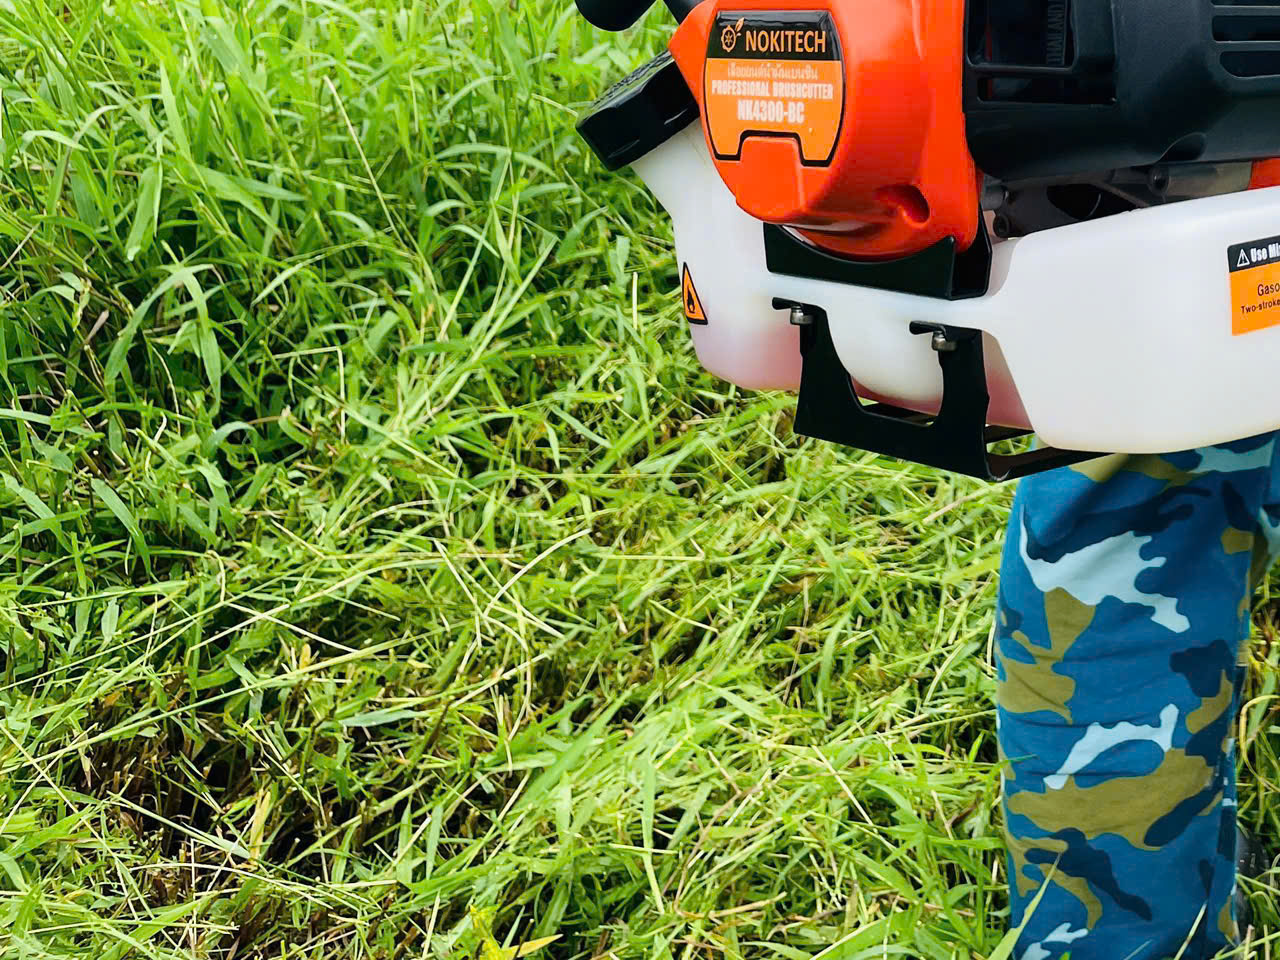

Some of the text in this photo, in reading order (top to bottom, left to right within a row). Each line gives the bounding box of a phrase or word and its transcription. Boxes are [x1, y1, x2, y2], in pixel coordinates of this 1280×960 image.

[745, 30, 826, 53] NOKITECH
[711, 80, 834, 100] PROFESSIONAL BRUSHCUTTER
[737, 99, 805, 124] NK4300-BC
[1250, 247, 1267, 263] Use
[1240, 298, 1280, 315] Two-stroke
